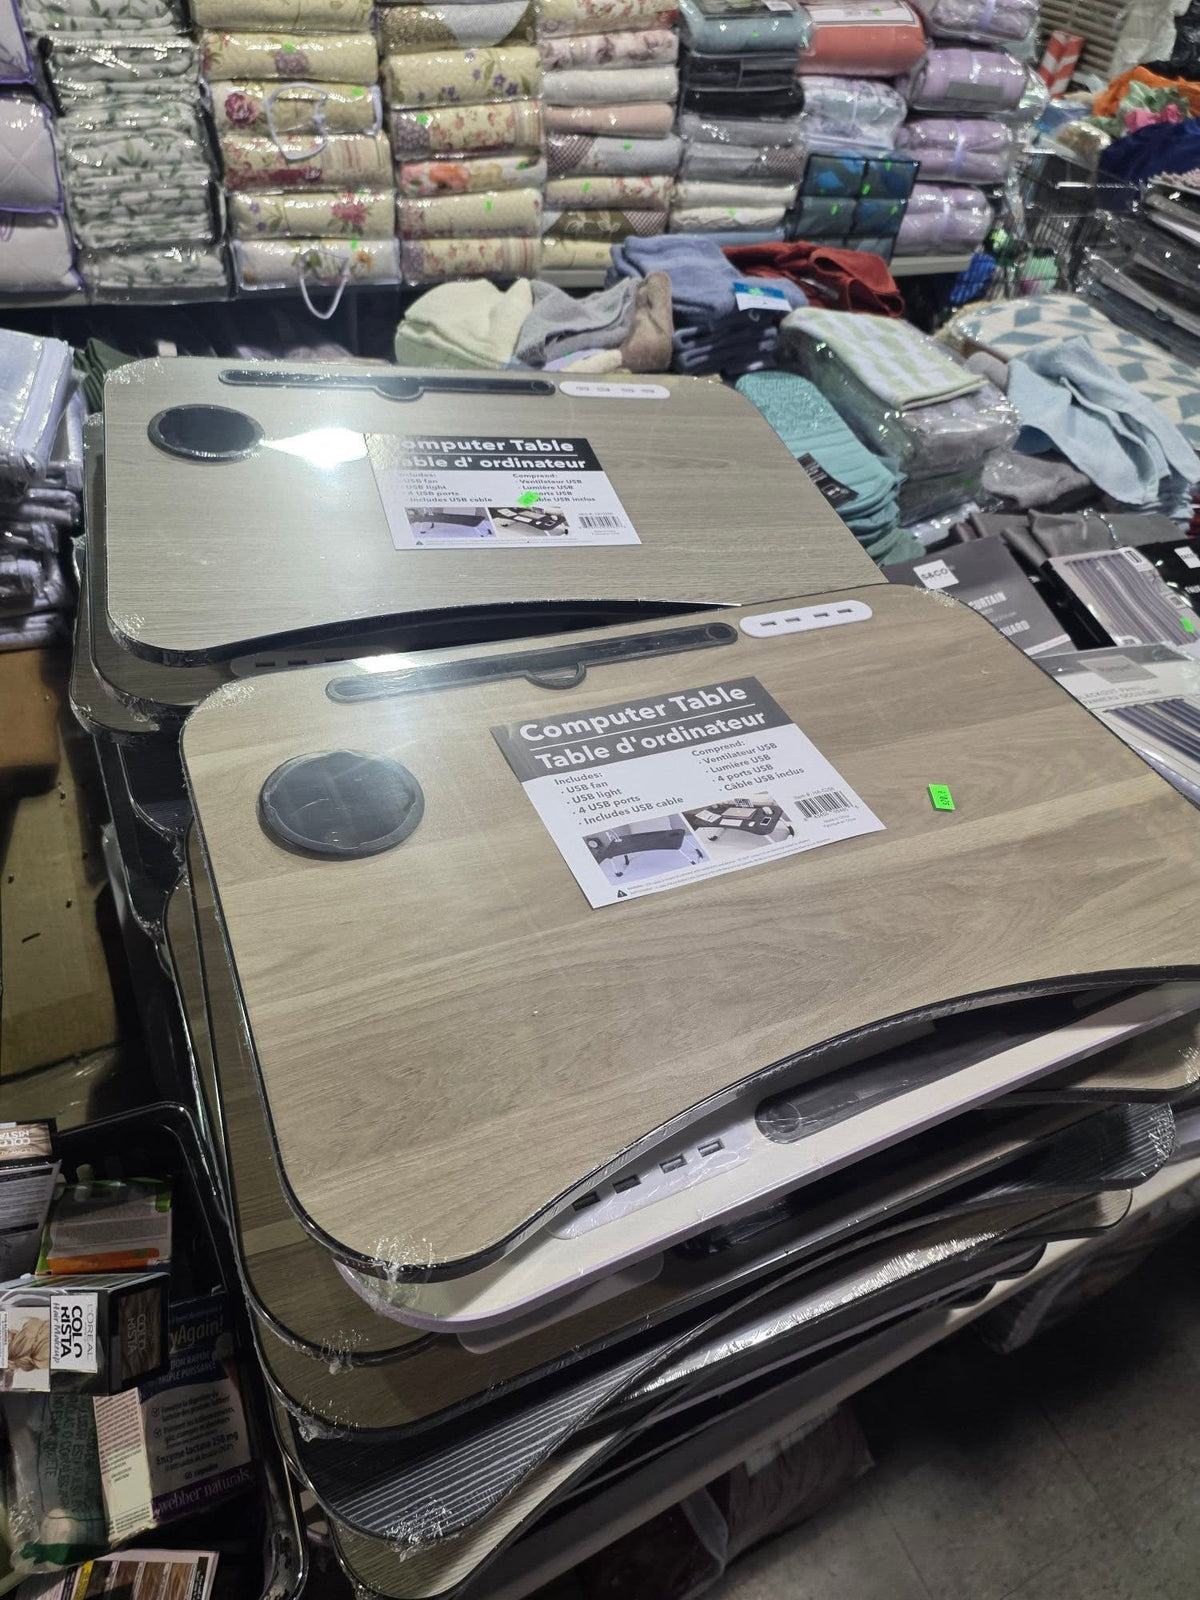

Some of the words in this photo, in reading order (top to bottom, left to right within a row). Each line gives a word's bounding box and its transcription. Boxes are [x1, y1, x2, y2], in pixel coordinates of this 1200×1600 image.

[398, 439, 506, 453] omputer
[509, 439, 575, 452] Table
[401, 455, 448, 468] able
[454, 456, 473, 468] d'
[479, 457, 586, 469] ordinateur
[920, 567, 949, 580] S&CO
[519, 702, 667, 742] Computer
[668, 685, 748, 713] Table
[534, 743, 611, 770] Table
[616, 711, 768, 753] d'ordinateur
[691, 740, 746, 757] Comprend:
[702, 749, 756, 765] Ventilateur
[756, 742, 778, 752] USB
[709, 760, 750, 773] Lumière
[750, 754, 771, 764] USB
[554, 772, 604, 785] Includes:
[724, 779, 753, 791] Câble
[753, 775, 775, 784] USB
[776, 767, 806, 779] inclus
[726, 770, 752, 782] ports
[752, 763, 774, 774] USB
[566, 783, 589, 794] USB
[590, 780, 609, 789] fan
[572, 793, 595, 804] USB
[596, 787, 623, 800] light
[578, 806, 586, 814] 4
[588, 800, 611, 812] USB
[613, 795, 641, 807] ports
[583, 809, 631, 825] Includes
[631, 802, 654, 813] USB
[655, 797, 685, 808] cable
[52, 1302, 61, 1325] Hair
[52, 1324, 61, 1365] Makeup
[168, 1313, 224, 1355] yAgain!
[155, 1450, 185, 1466] Enzyme
[226, 1431, 239, 1442] mg
[158, 1484, 203, 1513] webber
[203, 1468, 250, 1498] naturals
